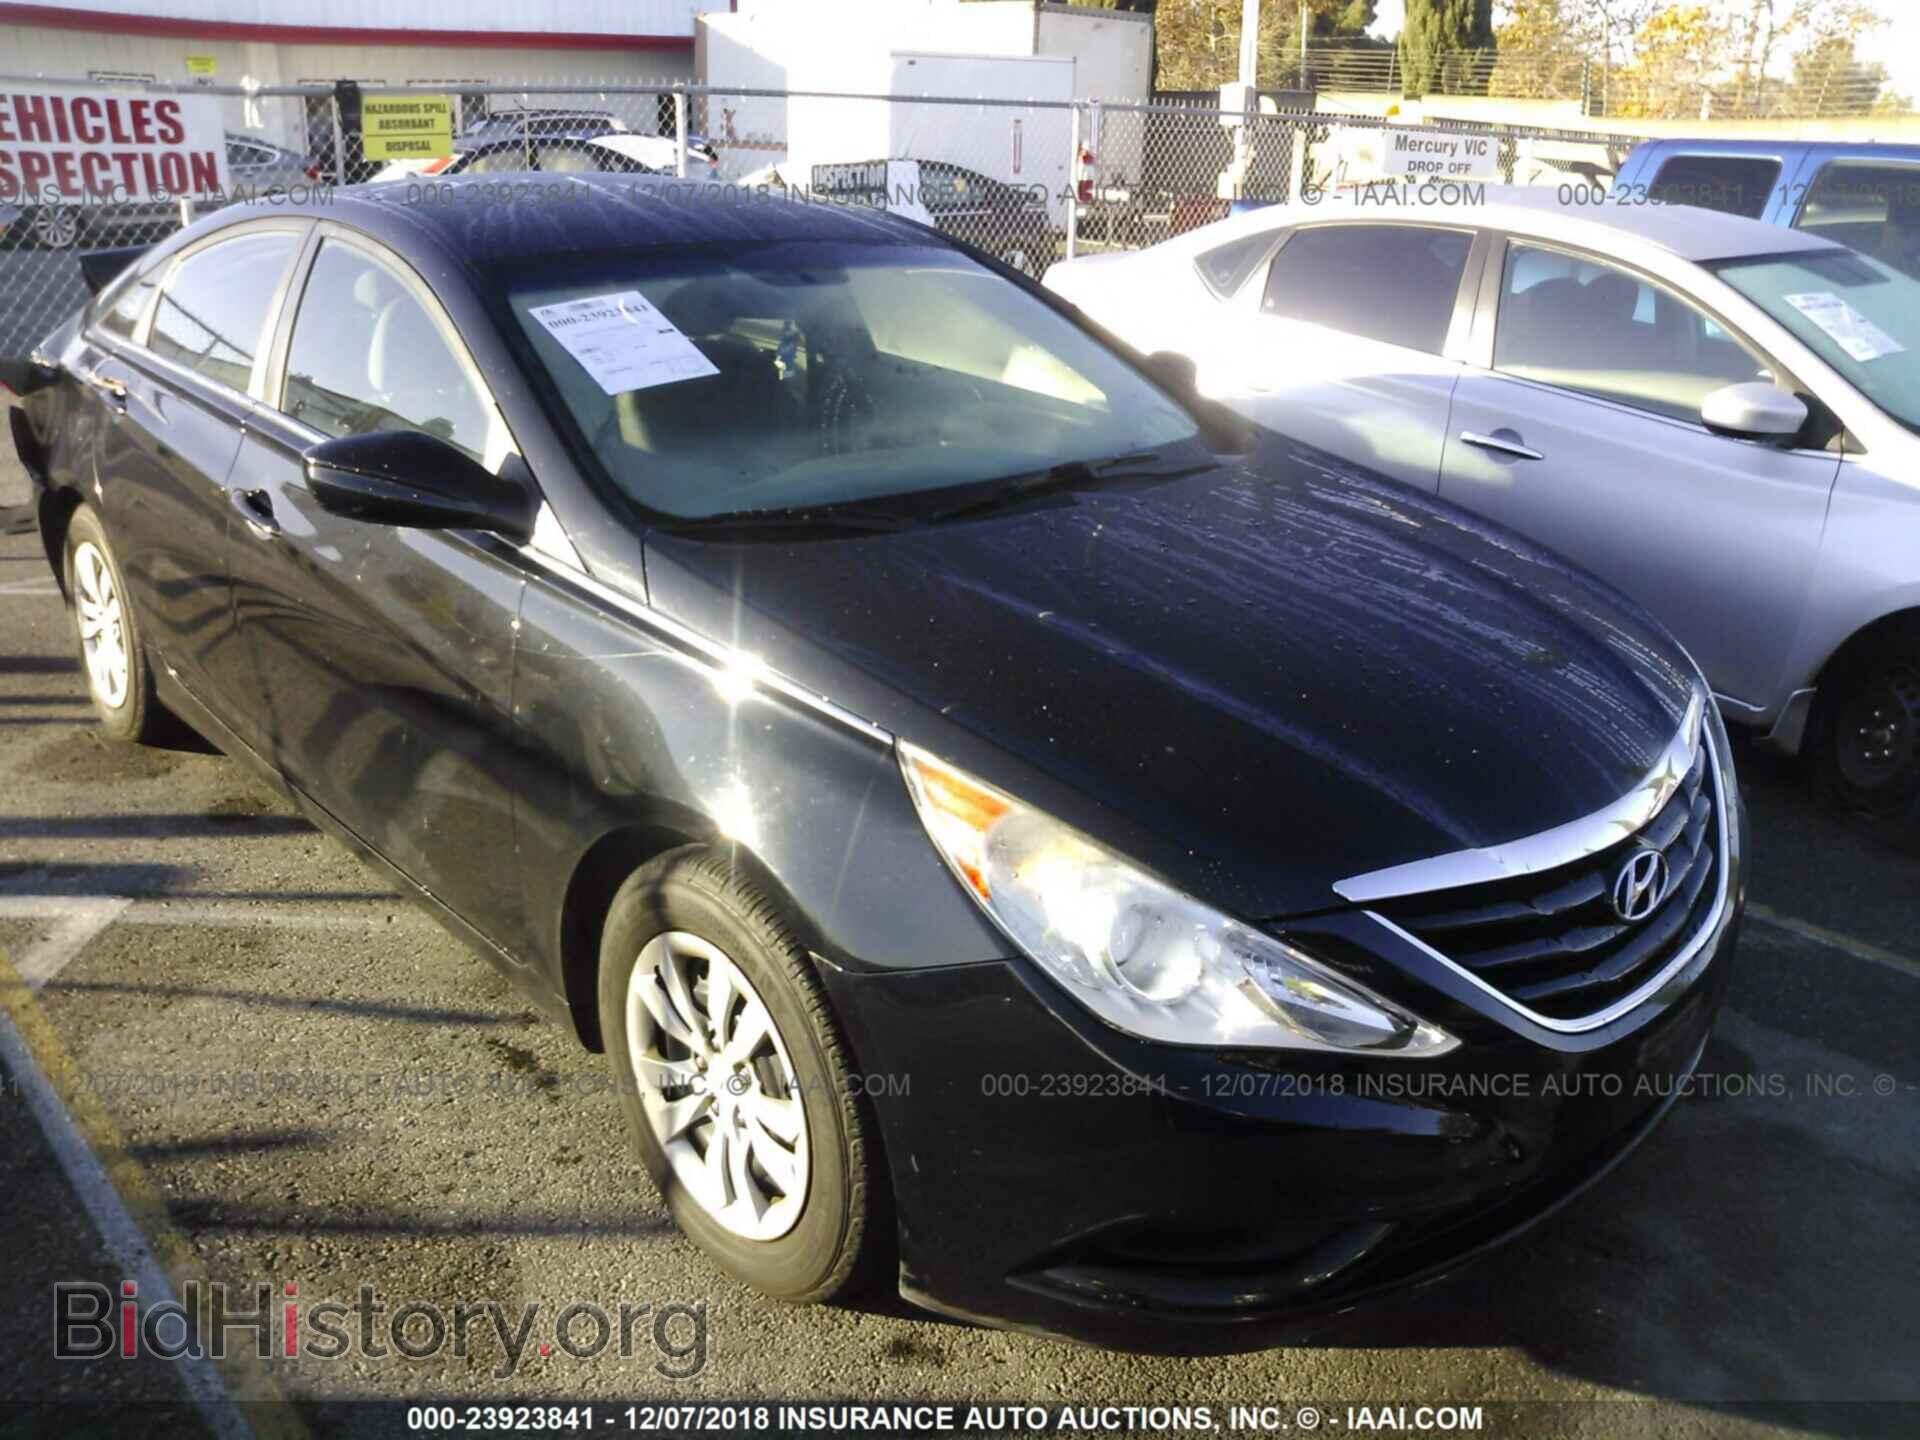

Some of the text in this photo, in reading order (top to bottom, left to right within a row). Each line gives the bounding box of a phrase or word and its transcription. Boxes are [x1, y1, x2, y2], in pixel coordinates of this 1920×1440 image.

[0, 93, 185, 145] EHICLES
[1394, 135, 1488, 157] Mercury VIC
[0, 149, 220, 197] SPECTION
[1407, 160, 1472, 175] DROP OFF
